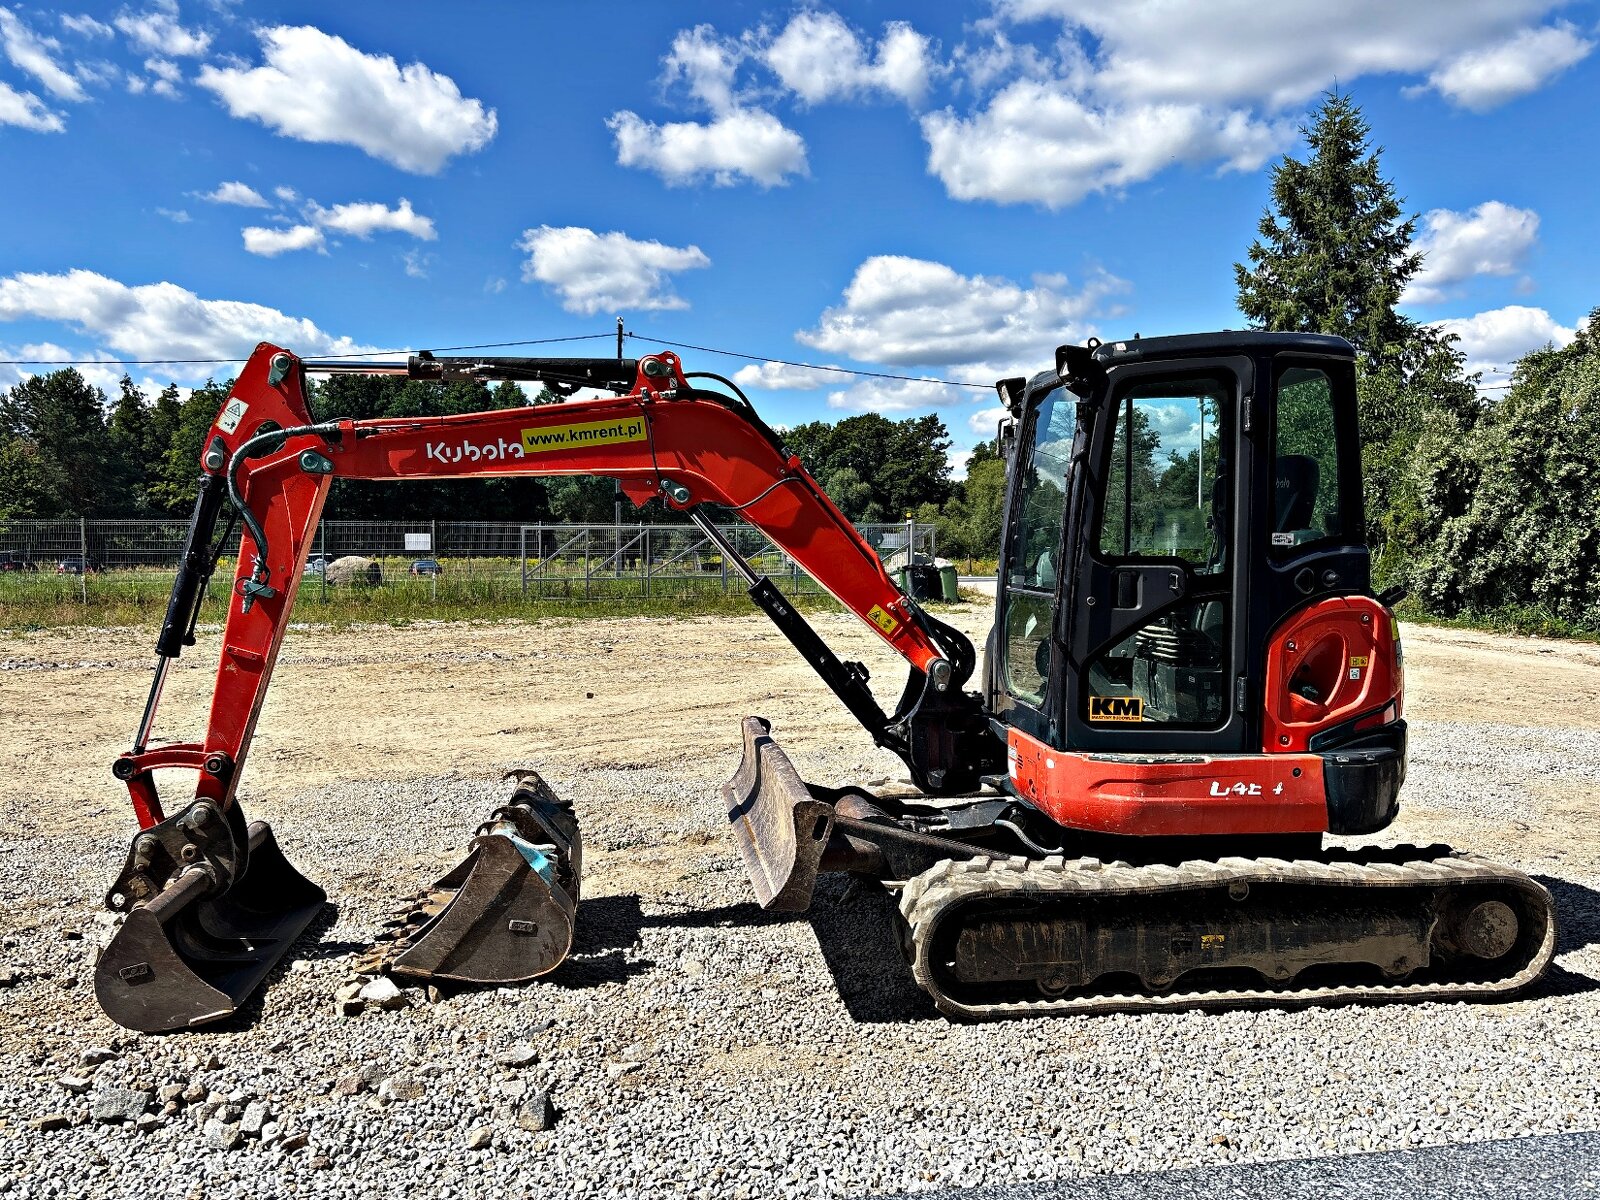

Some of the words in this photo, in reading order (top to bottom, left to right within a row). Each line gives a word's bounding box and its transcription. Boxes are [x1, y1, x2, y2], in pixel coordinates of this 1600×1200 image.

[526, 421, 642, 446] www.kmrent.pl
[426, 438, 525, 463] Kubota
[1091, 698, 1140, 716] KM
